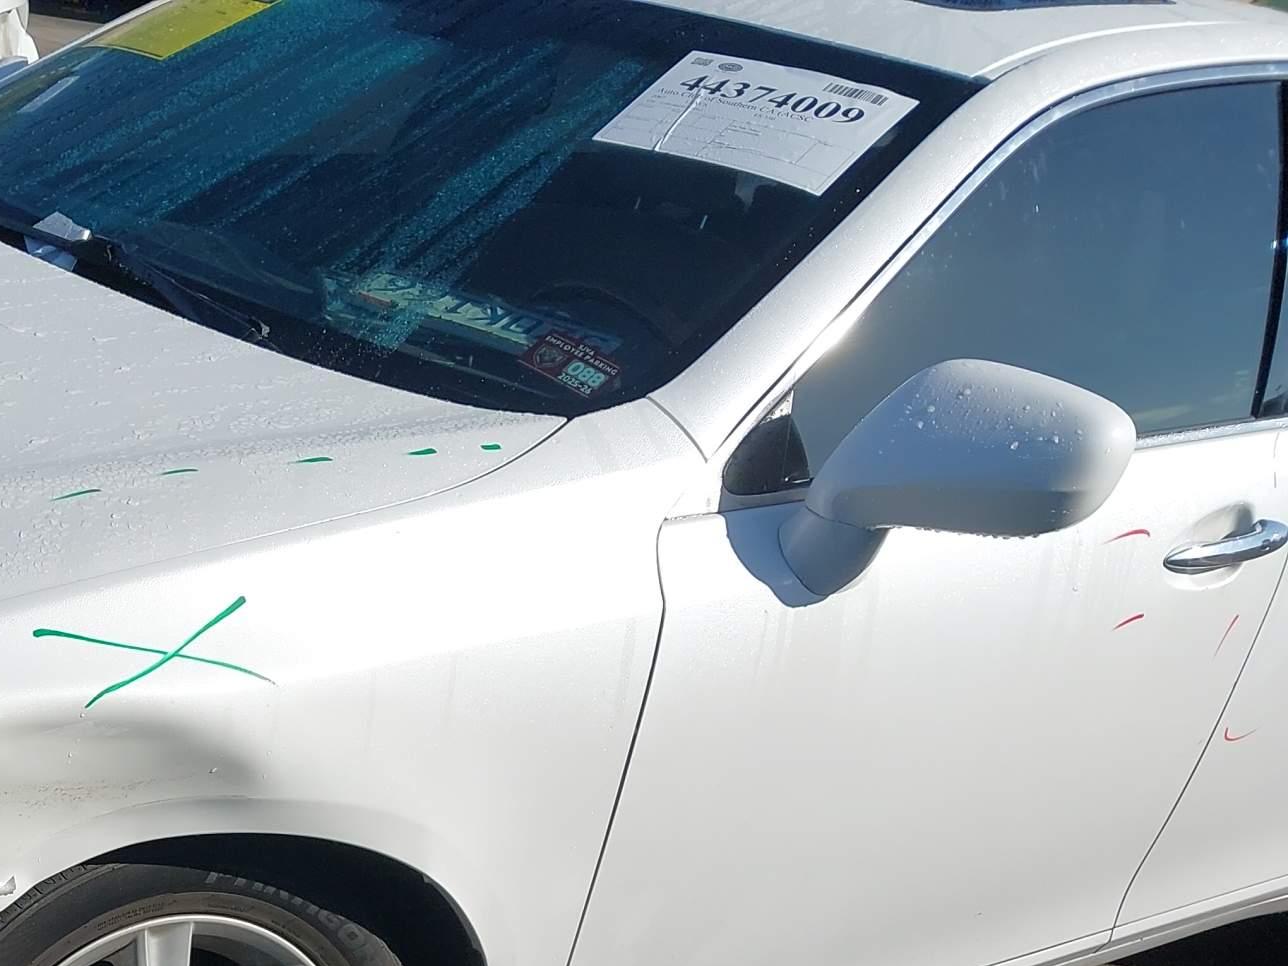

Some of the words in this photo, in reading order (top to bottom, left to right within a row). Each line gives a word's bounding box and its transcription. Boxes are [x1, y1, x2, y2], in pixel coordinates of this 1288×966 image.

[679, 75, 865, 124] 44374009
[717, 98, 757, 111] Southern
[545, 335, 584, 358] EMPLOYEE
[583, 354, 618, 376] PARKING
[557, 372, 593, 395] 2025-26
[567, 361, 606, 388] 088
